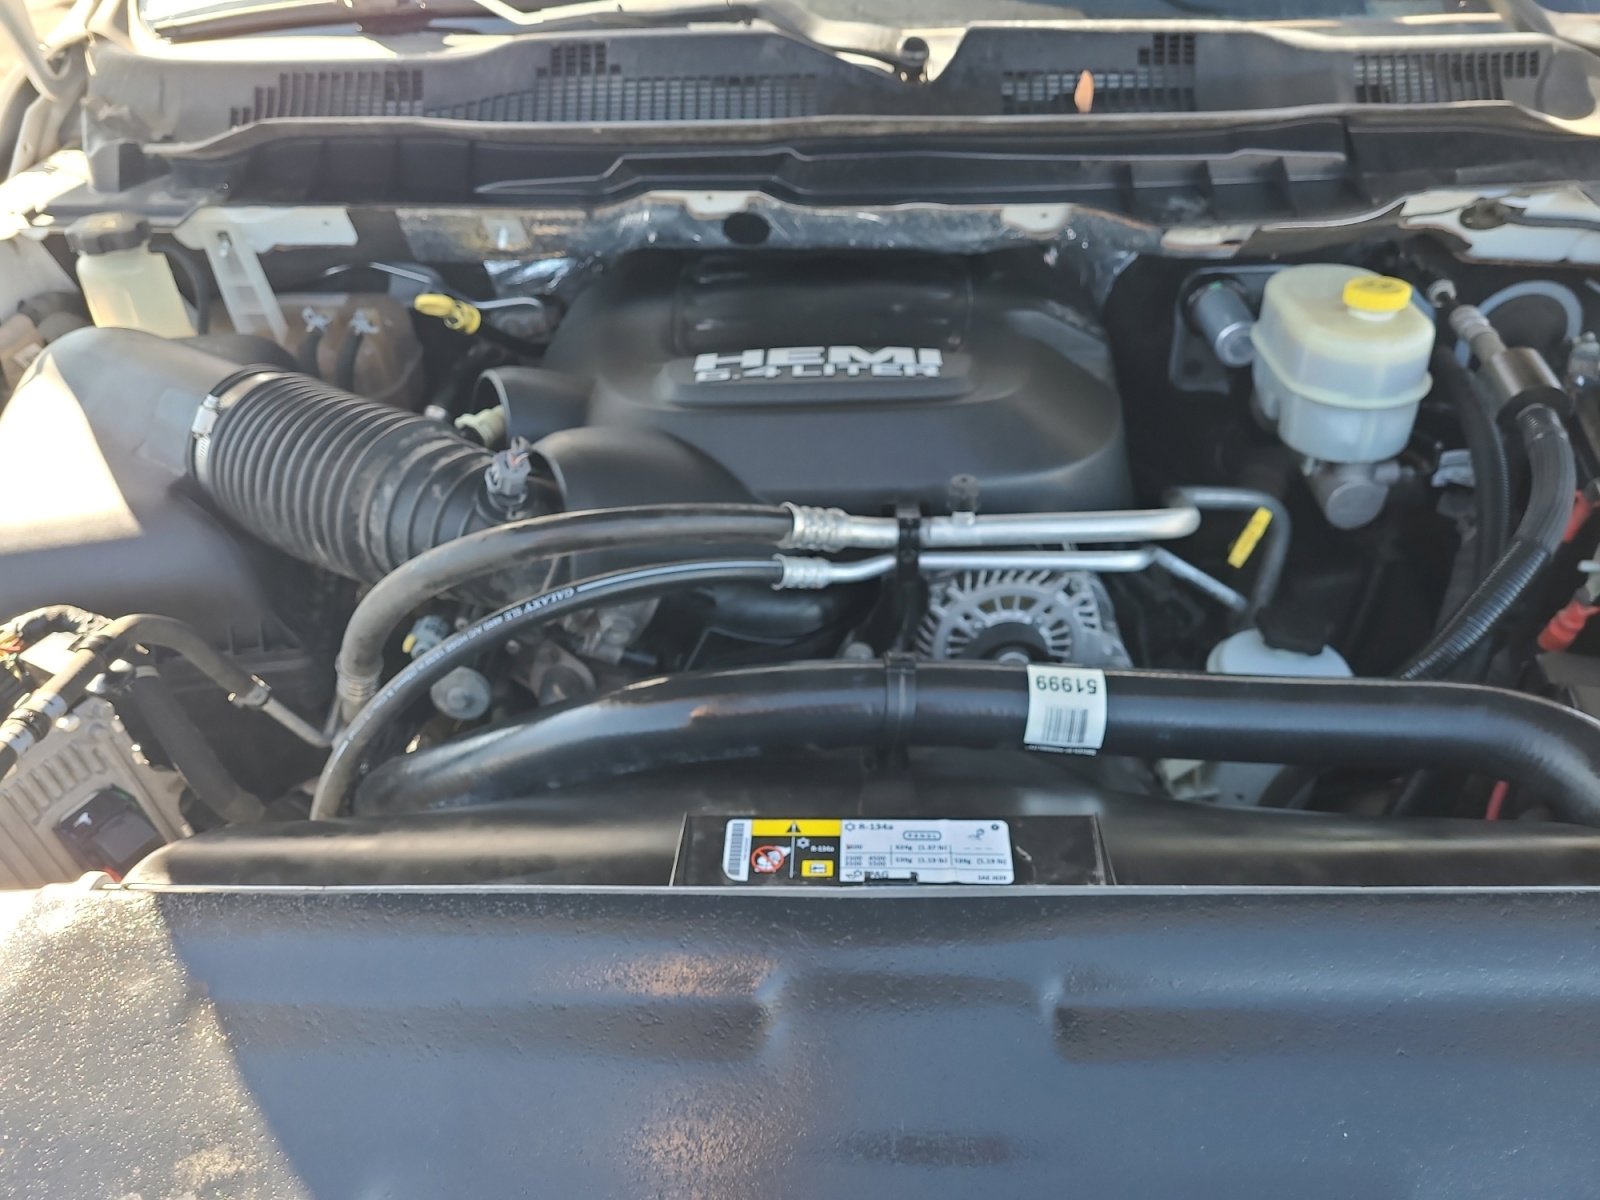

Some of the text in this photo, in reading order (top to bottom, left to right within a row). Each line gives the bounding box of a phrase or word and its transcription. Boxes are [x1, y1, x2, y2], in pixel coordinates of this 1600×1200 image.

[693, 346, 943, 372] HEMI
[792, 364, 941, 378] LITER
[523, 587, 574, 614] GALAXY
[1036, 675, 1097, 695] 51999
